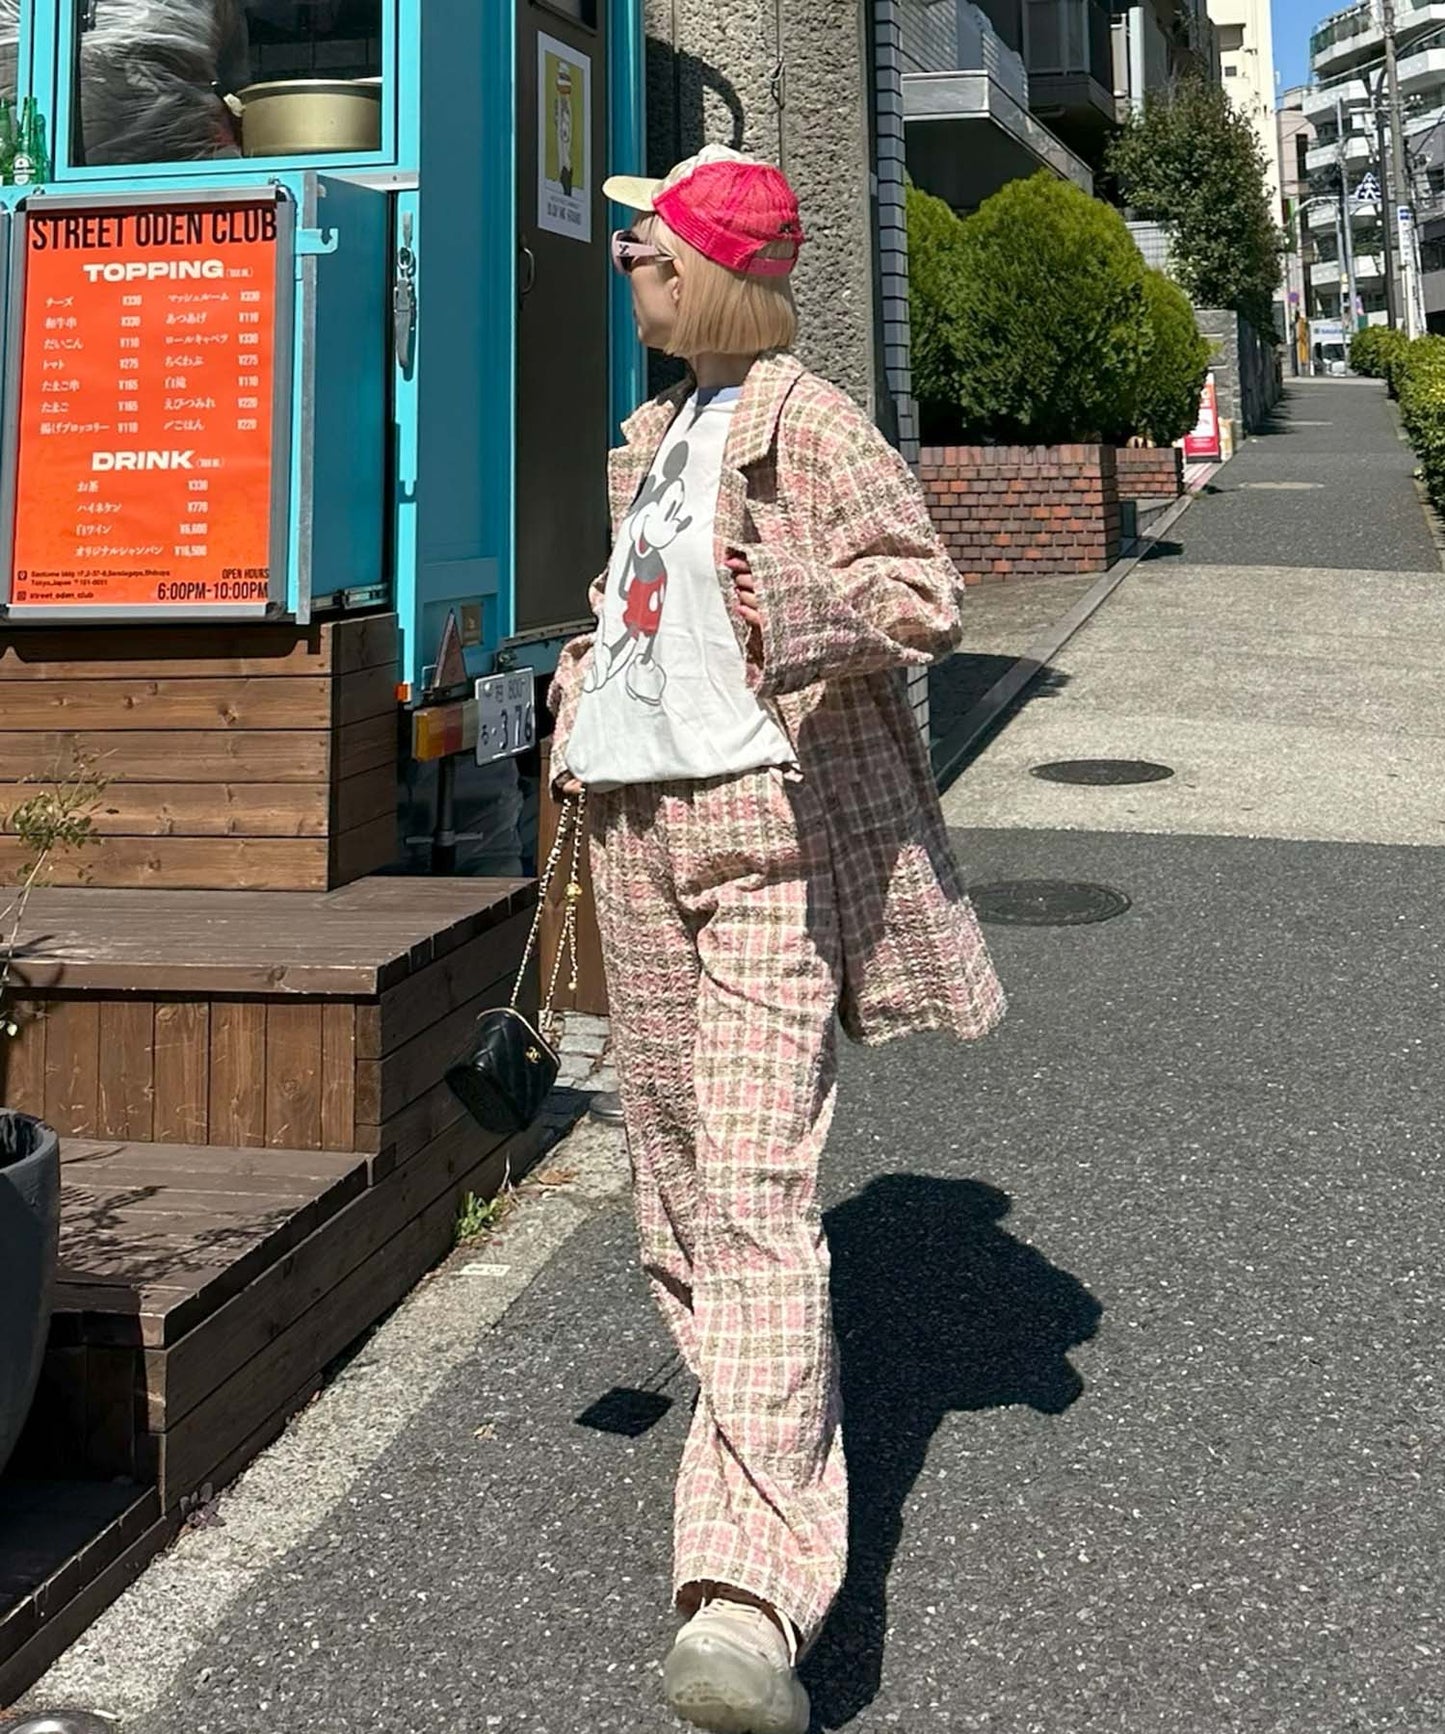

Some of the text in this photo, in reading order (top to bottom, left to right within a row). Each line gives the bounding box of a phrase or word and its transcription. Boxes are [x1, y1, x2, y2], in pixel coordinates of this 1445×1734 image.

[32, 208, 277, 250] STREET ODEN CLUB
[83, 259, 224, 282] TOPPING
[239, 312, 259, 322] ¥110
[120, 337, 139, 348] ¥110
[118, 422, 138, 433] ¥110
[92, 450, 194, 471] DRINK
[222, 568, 269, 580] OPEN HOURS
